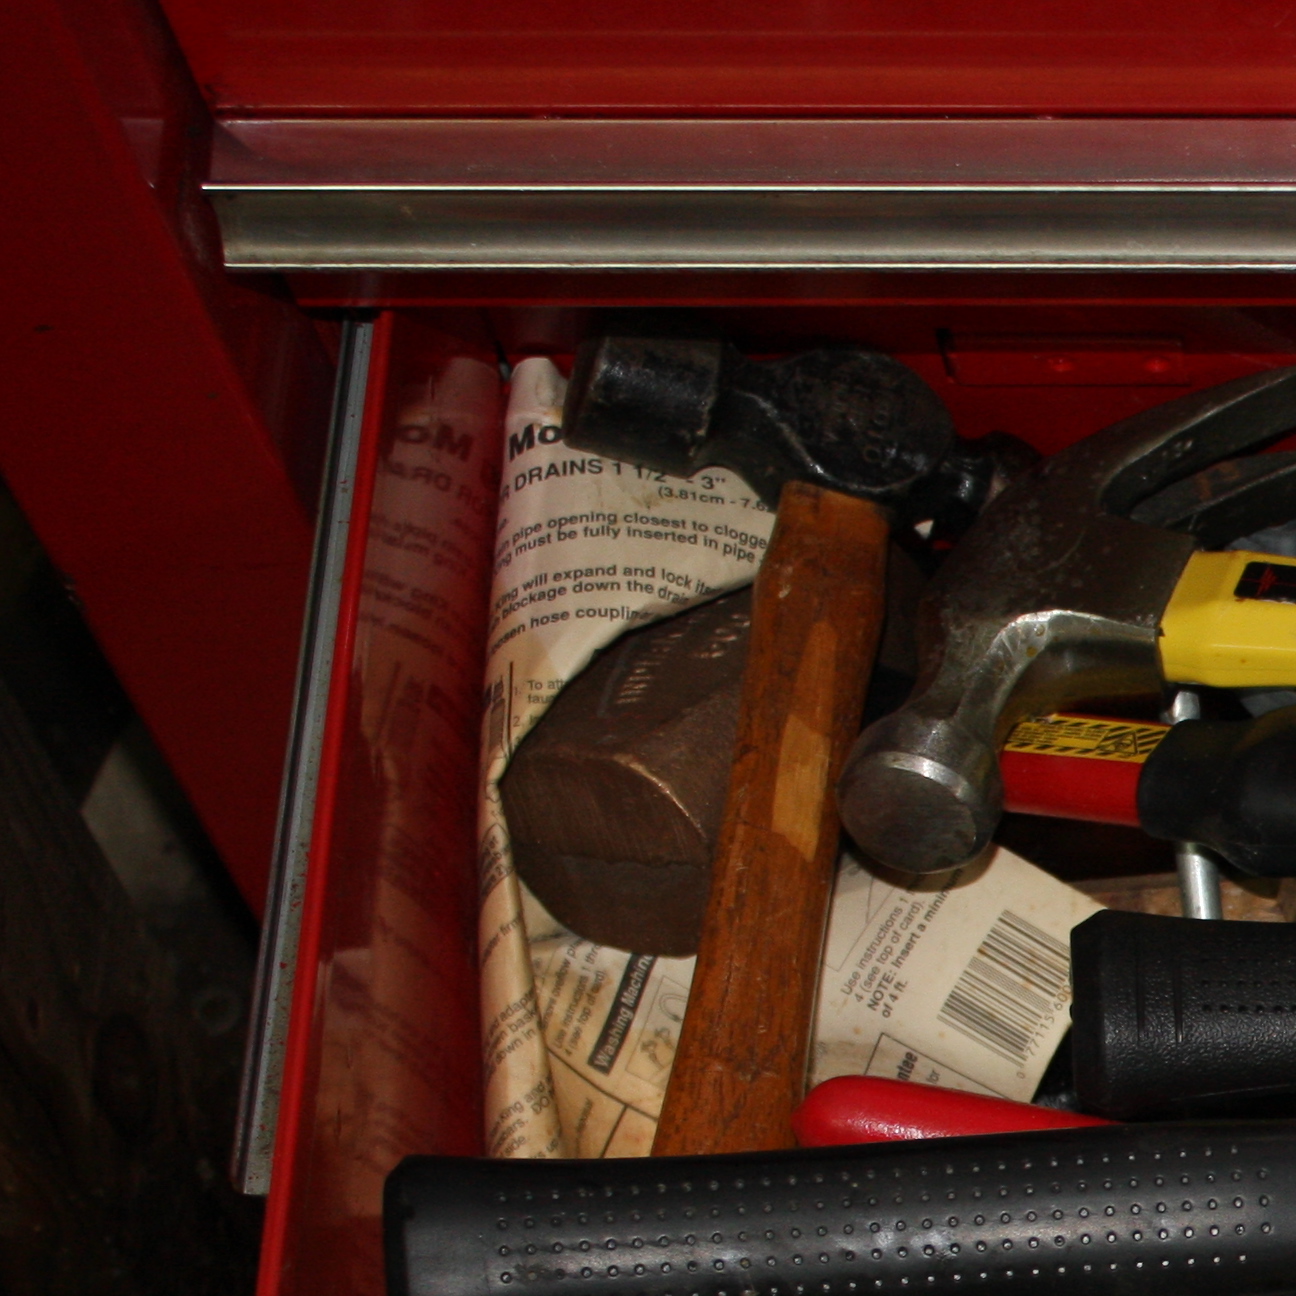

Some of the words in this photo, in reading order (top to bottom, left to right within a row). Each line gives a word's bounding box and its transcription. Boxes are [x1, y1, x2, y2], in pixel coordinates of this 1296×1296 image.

[514, 459, 602, 491] DRAINS
[658, 486, 724, 505] (3.81cm
[512, 522, 541, 545] pipe
[547, 511, 617, 529] opening
[624, 509, 686, 529] closest
[691, 518, 709, 532] to
[715, 524, 767, 550] clogge
[515, 534, 551, 556] must
[557, 526, 577, 541] be
[584, 525, 620, 540] fully
[627, 525, 698, 545] inserted
[704, 535, 718, 549] in
[723, 542, 756, 565] pipe
[522, 573, 548, 592] will
[553, 565, 617, 583] expand
[623, 564, 655, 578] and
[661, 567, 692, 589] lock
[502, 586, 566, 619] blockage
[572, 580, 620, 594] down
[626, 579, 654, 593] the
[530, 610, 570, 630] hose
[527, 679, 543, 690] To
[840, 968, 862, 996] Use
[858, 905, 904, 972] instructions
[854, 992, 864, 1003] 4
[860, 967, 881, 997] (see
[876, 945, 894, 971] top
[891, 927, 903, 946] of
[867, 970, 898, 1012] NOTE:
[892, 934, 921, 970] Insert
[917, 924, 928, 935] a
[880, 1004, 893, 1019] of
[889, 991, 901, 1003] 4
[594, 1006, 634, 1068] Washing
